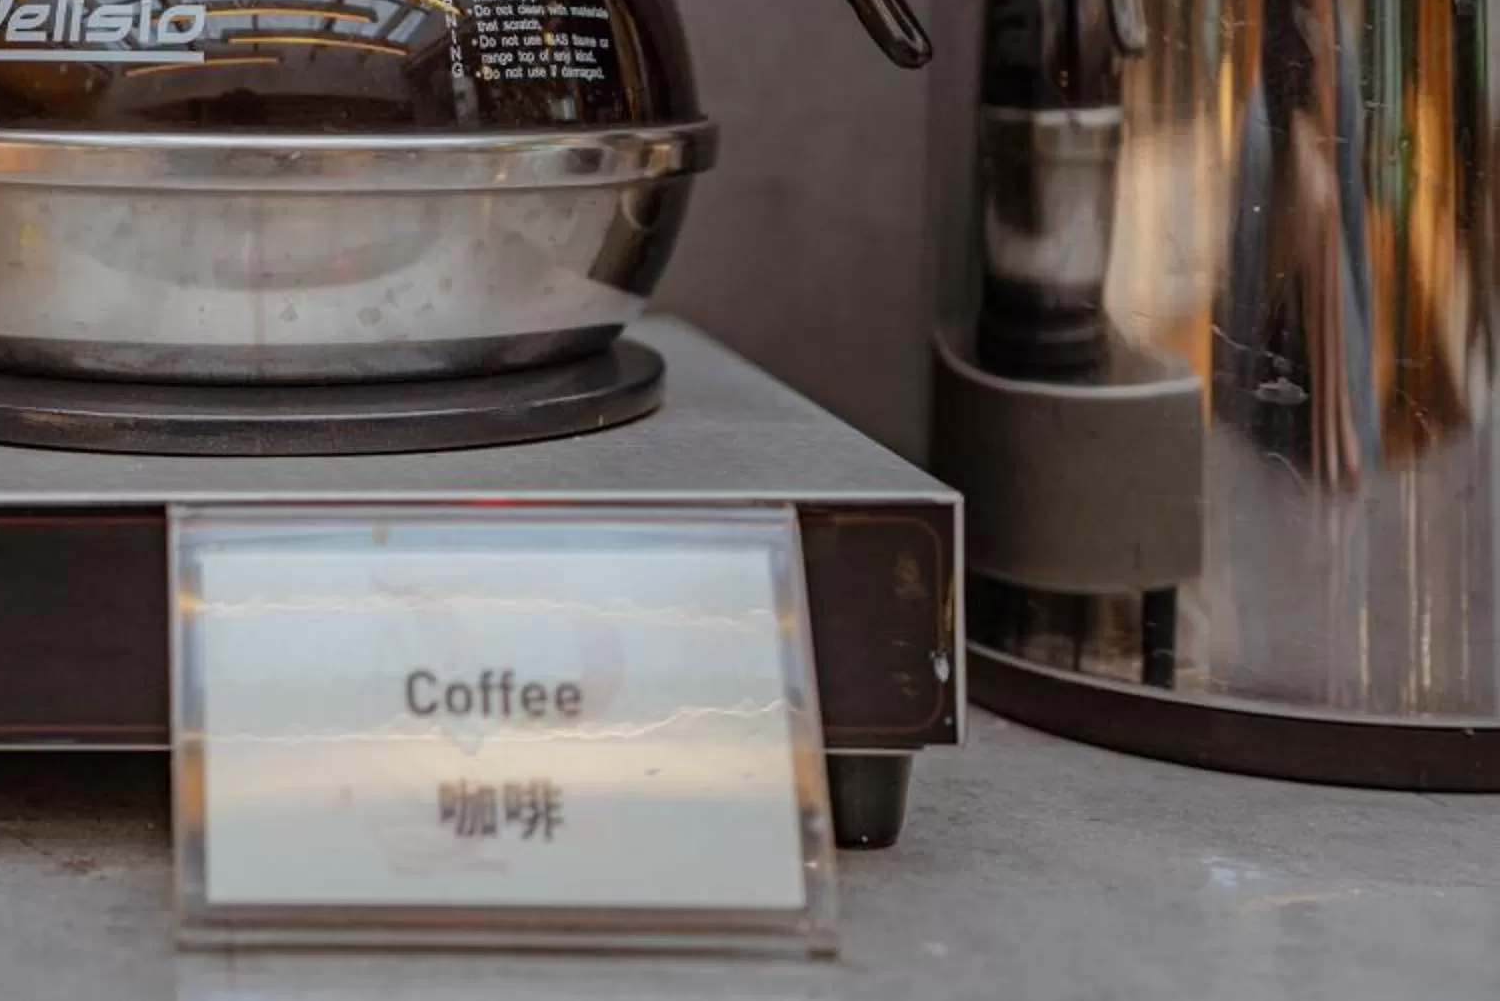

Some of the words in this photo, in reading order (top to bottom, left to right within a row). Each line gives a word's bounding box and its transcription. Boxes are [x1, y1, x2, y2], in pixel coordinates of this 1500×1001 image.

[474, 5, 491, 19] Do
[480, 34, 497, 50] Do
[501, 33, 519, 47] not
[523, 35, 542, 47] use
[482, 52, 513, 66] range
[518, 50, 535, 64] top
[483, 66, 501, 81] Do
[505, 66, 523, 79] not
[528, 66, 547, 79] use
[405, 668, 584, 719] Coffee
[438, 776, 565, 844] 咖啡
